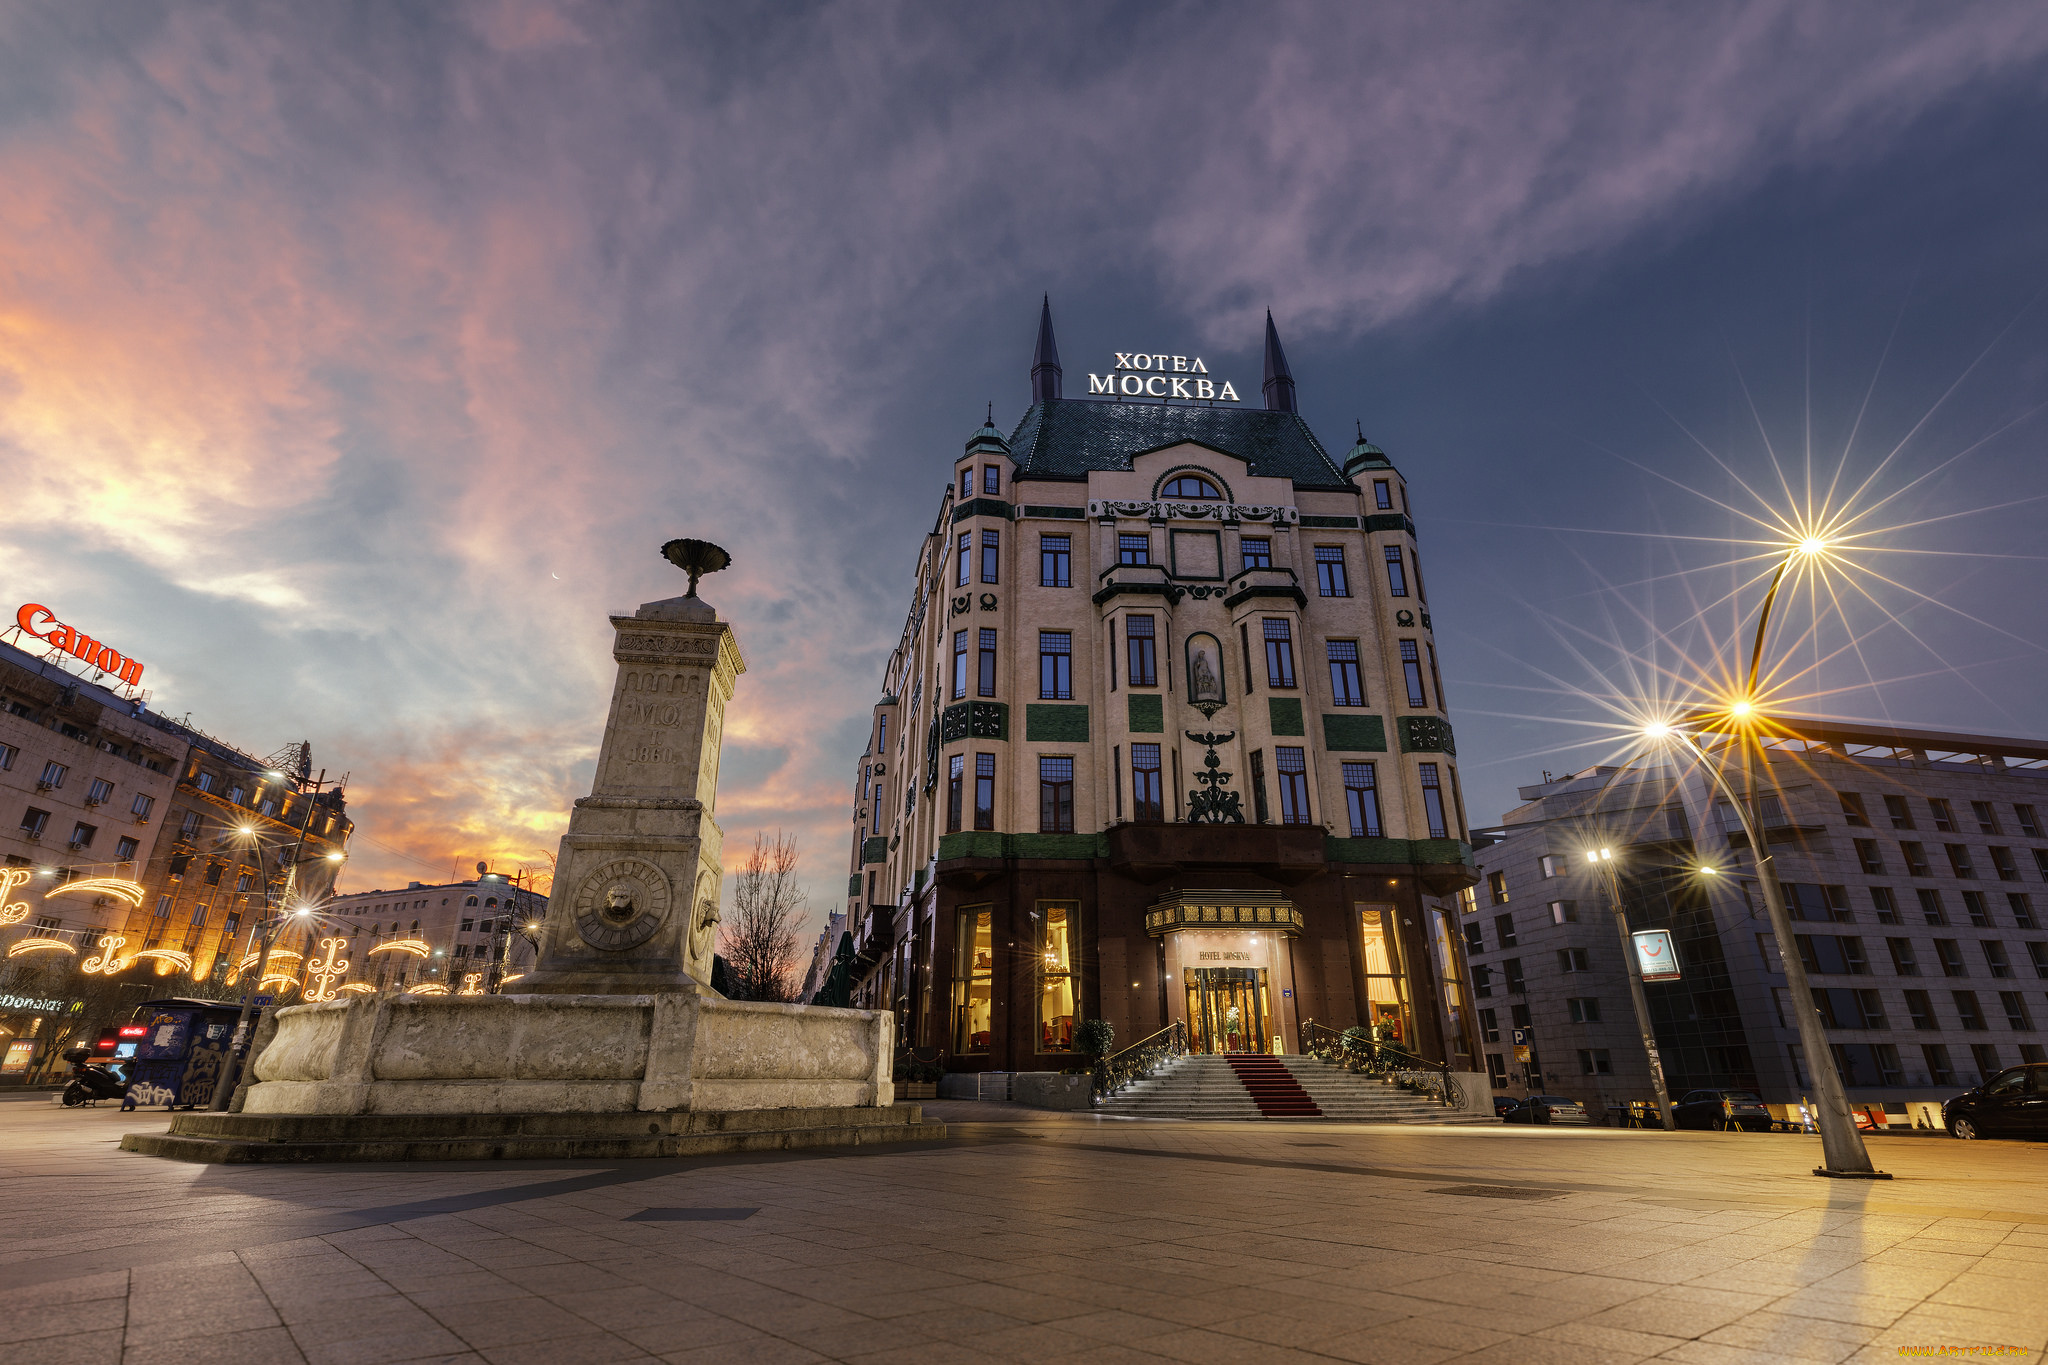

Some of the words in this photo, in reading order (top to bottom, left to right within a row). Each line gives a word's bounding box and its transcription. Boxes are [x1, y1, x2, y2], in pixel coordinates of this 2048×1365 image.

[1114, 352, 1208, 373] ХОТЕЛ
[1088, 374, 1240, 401] МОСКВА
[17, 603, 145, 686] Canon
[1199, 951, 1221, 960] HOTEL
[1223, 951, 1251, 960] MOSKVA
[1514, 1031, 1523, 1043] P
